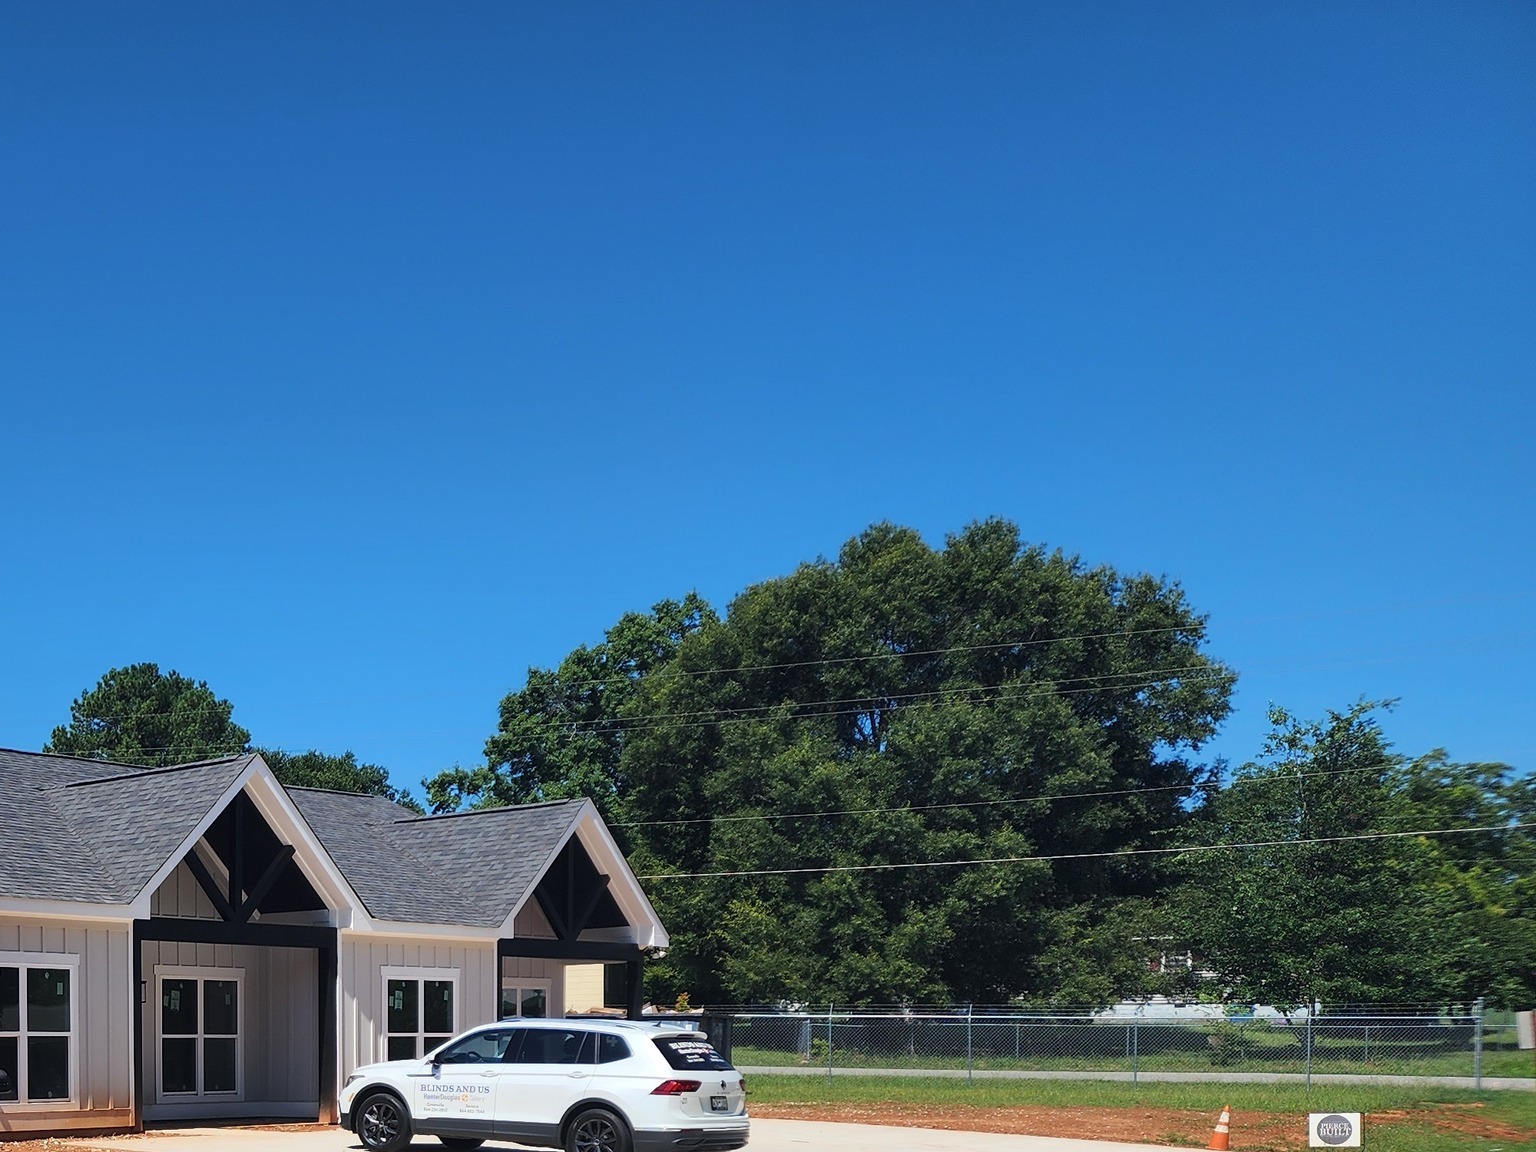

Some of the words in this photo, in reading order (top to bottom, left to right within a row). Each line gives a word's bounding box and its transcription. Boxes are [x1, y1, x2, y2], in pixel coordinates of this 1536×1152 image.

[420, 1084, 454, 1092] BLINDS
[478, 1086, 490, 1094] US
[1320, 1128, 1351, 1136] BUILT
